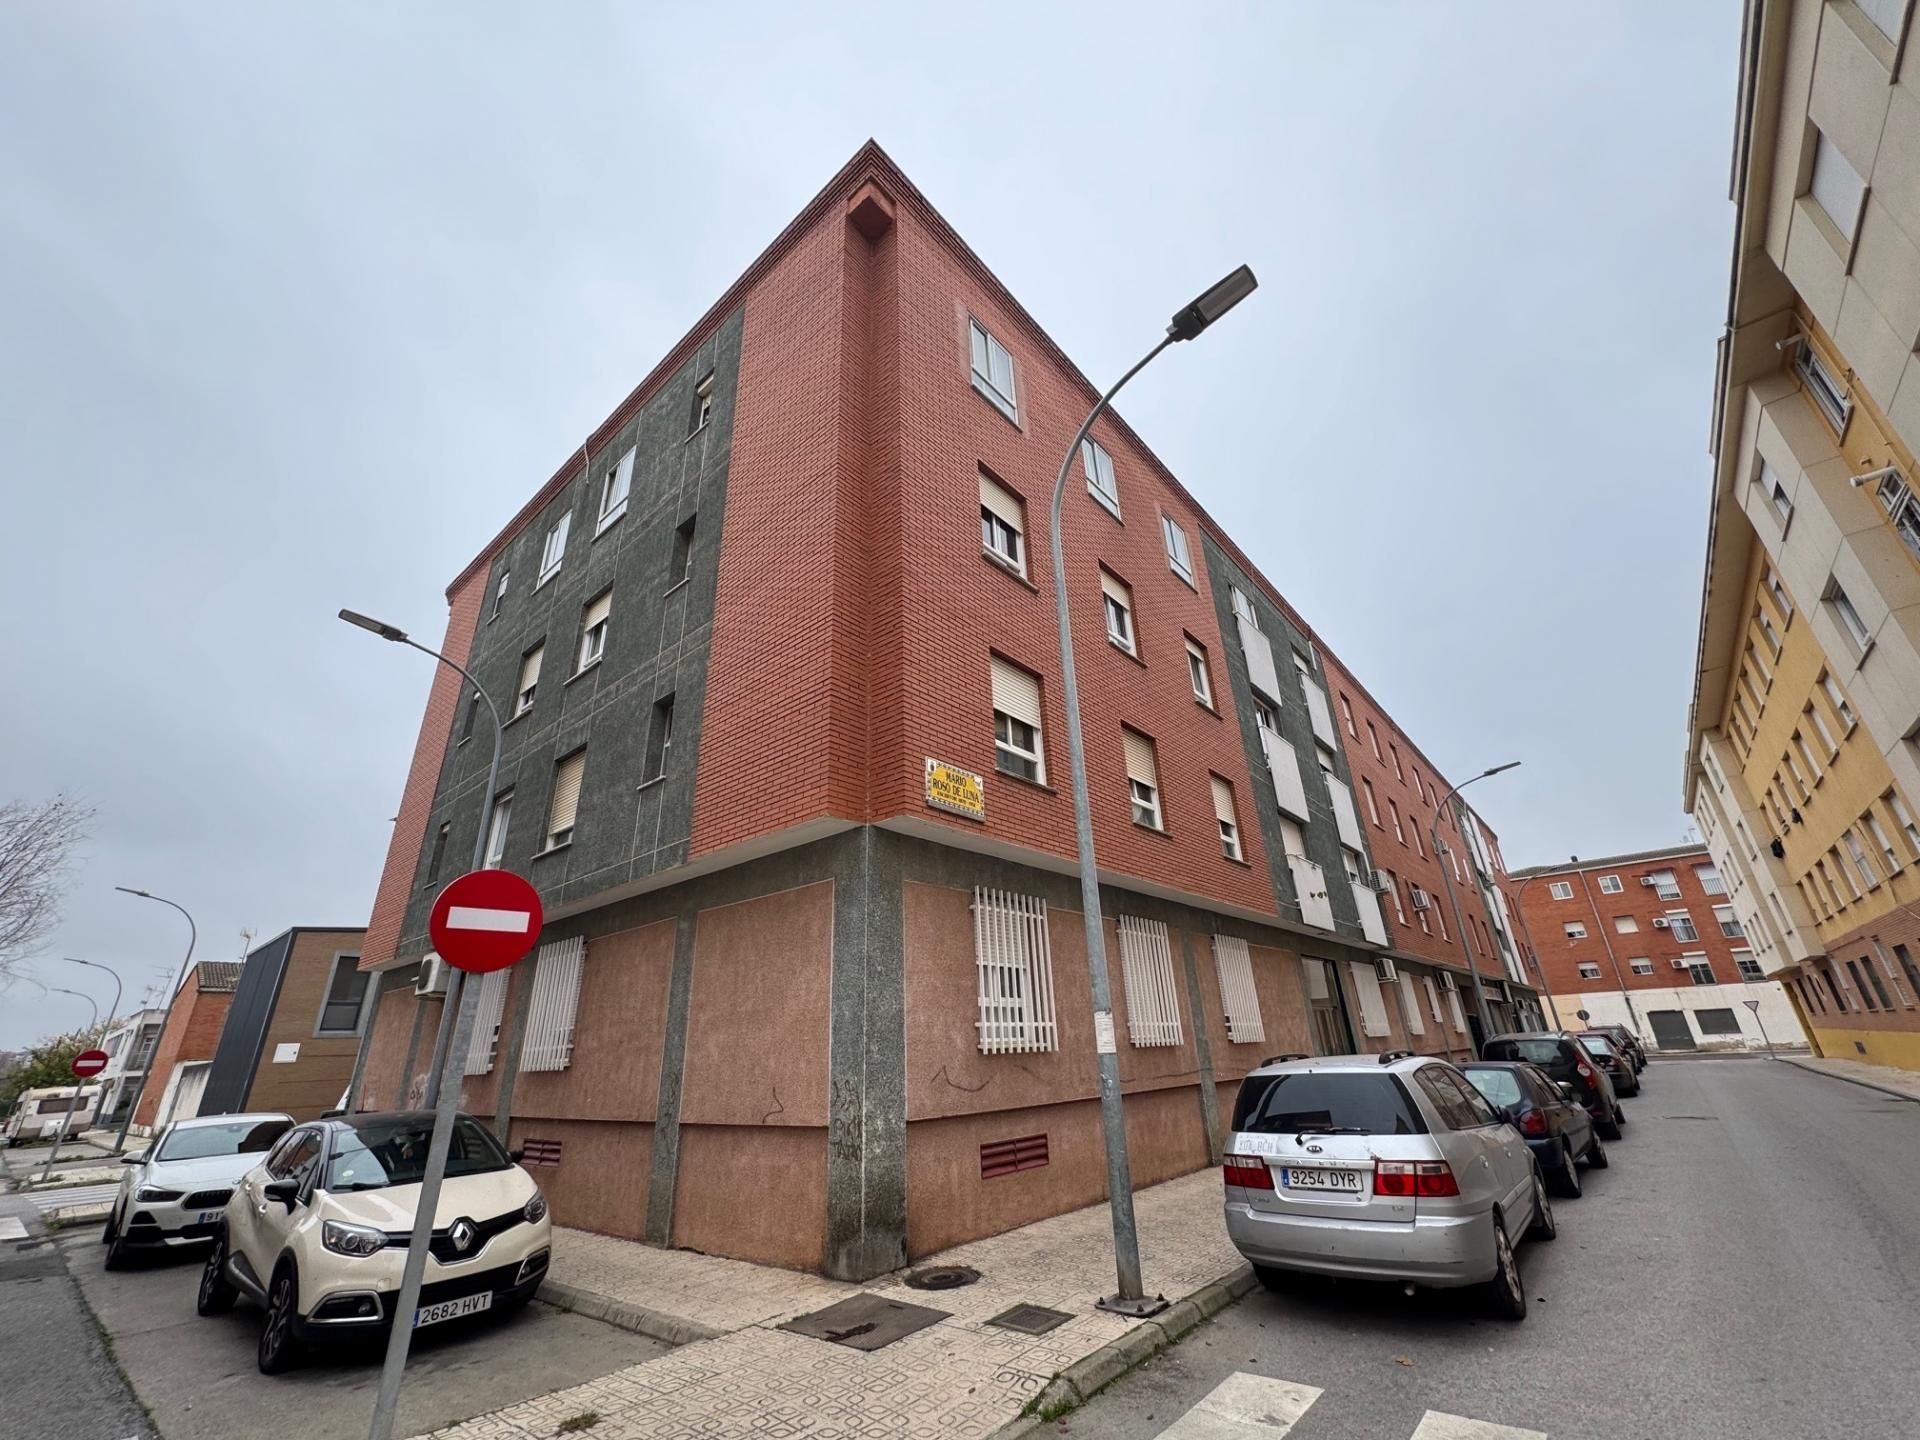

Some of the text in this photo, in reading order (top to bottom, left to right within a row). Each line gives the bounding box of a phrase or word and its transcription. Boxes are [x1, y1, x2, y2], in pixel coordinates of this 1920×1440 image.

[933, 778, 951, 793] ROSO
[952, 785, 962, 797] DE
[963, 789, 980, 803] LUNA
[946, 772, 967, 788] MARIO
[1291, 1170, 1357, 1188] 9254 DYR
[421, 1294, 489, 1324] 2682 HVT
